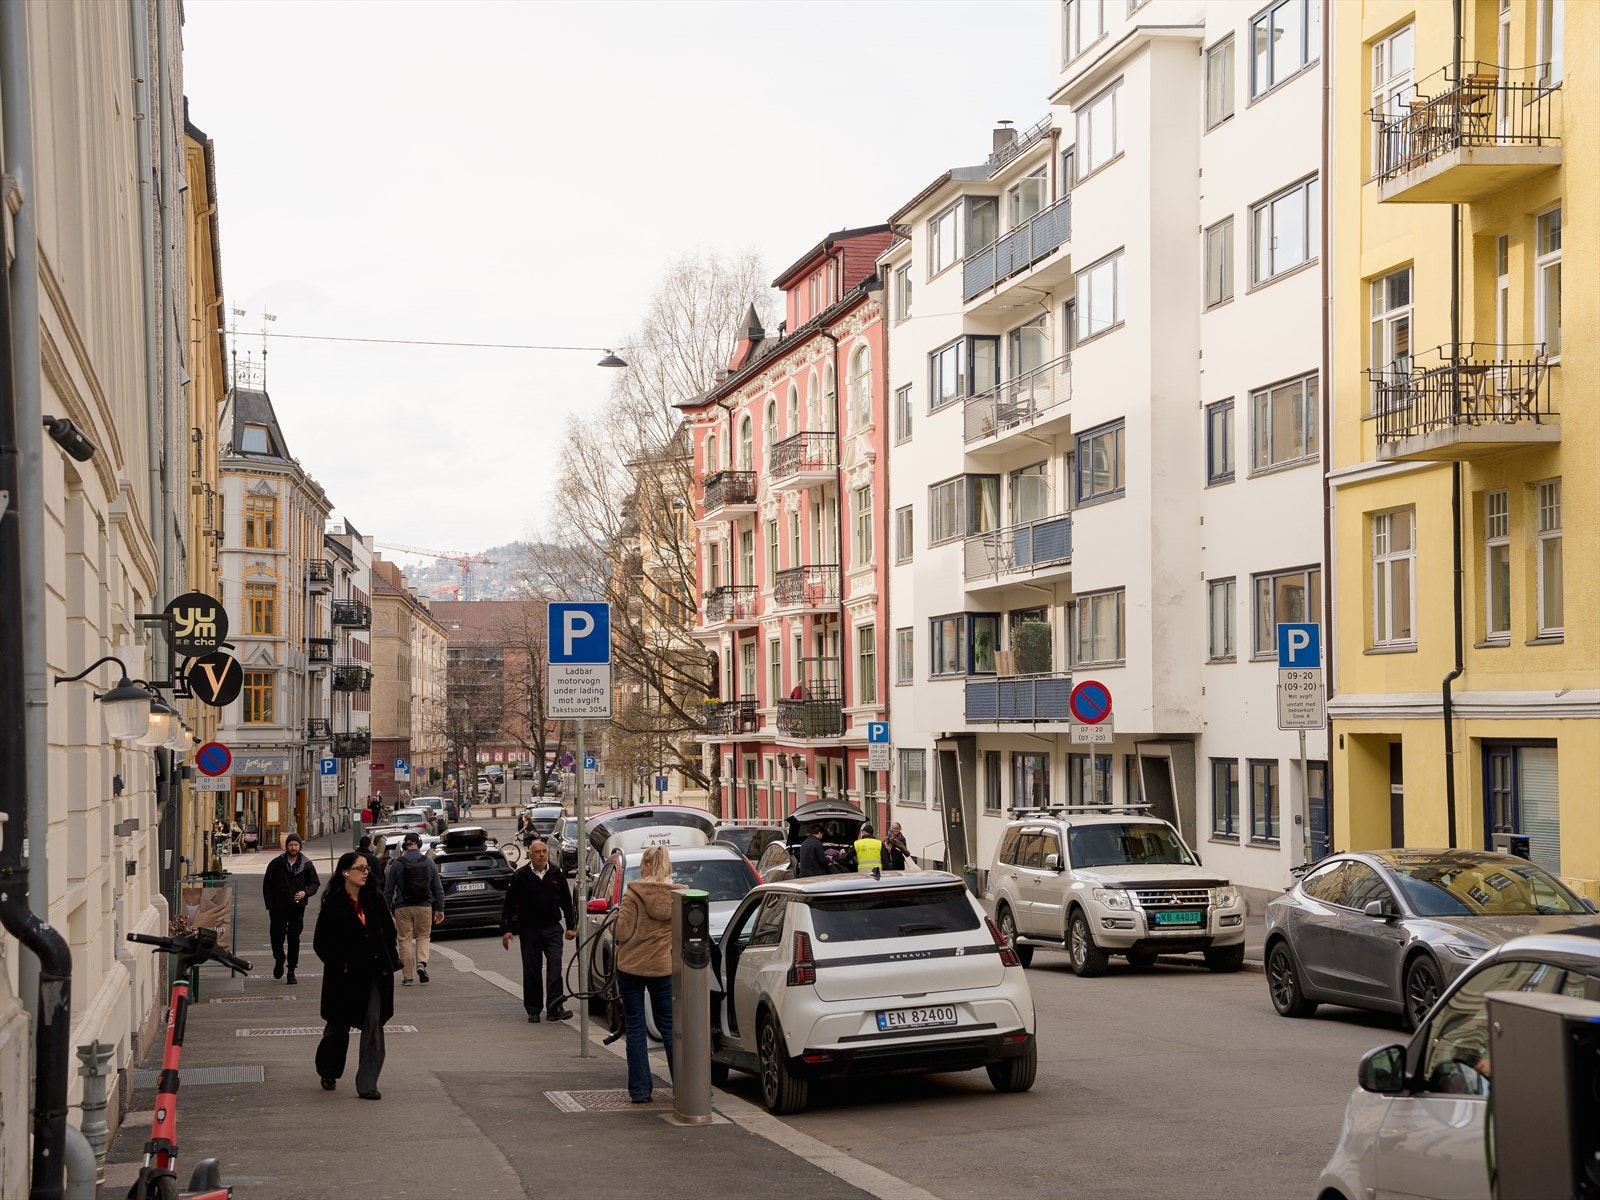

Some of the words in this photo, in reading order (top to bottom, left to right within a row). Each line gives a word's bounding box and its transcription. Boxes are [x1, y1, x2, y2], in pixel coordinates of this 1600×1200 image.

[563, 610, 595, 655] P
[194, 638, 216, 646] cha
[1288, 629, 1310, 662] P
[565, 667, 593, 675] Ladbar
[557, 678, 601, 686] motorvogn
[553, 687, 577, 695] under
[579, 687, 604, 696] lading
[576, 696, 600, 705] avgift
[873, 724, 884, 741] P
[324, 760, 333, 773] P
[397, 759, 403, 767] P
[586, 758, 593, 768] P
[1161, 913, 1172, 922] KB
[1175, 913, 1199, 922] 44037
[889, 951, 932, 960] RENAULT
[888, 1011, 906, 1026] EN
[911, 1007, 953, 1023] 82400
